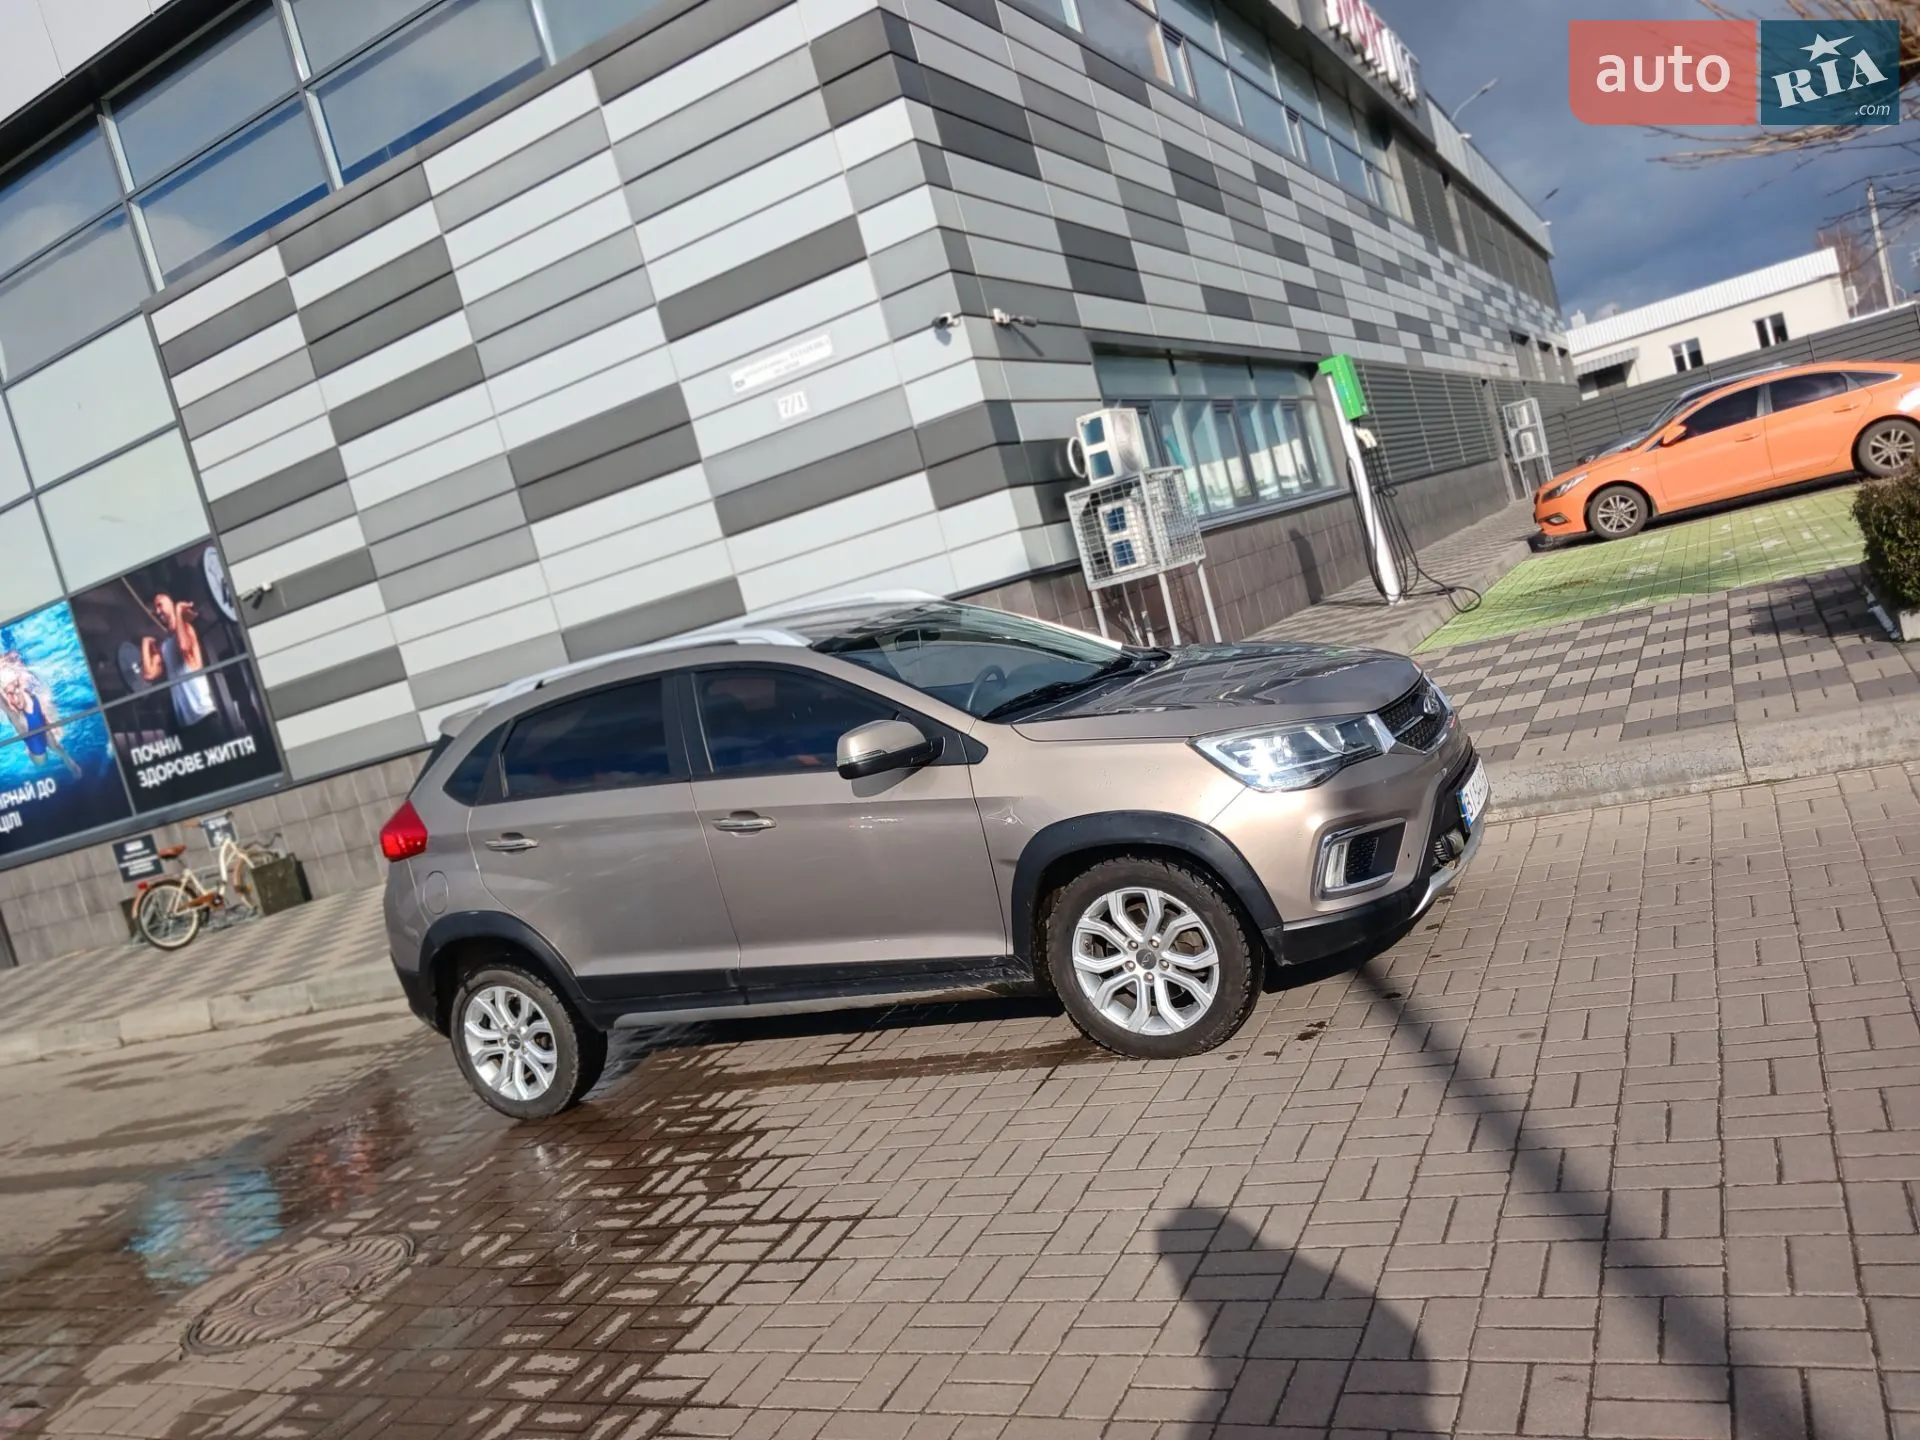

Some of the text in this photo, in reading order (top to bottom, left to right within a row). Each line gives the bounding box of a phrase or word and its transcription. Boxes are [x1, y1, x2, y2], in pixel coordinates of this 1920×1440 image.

[130, 735, 183, 766] ПОЧНИ
[136, 735, 256, 789] ЗДОРОВЕ ЖИТТЯ
[36, 777, 57, 801] ДО
